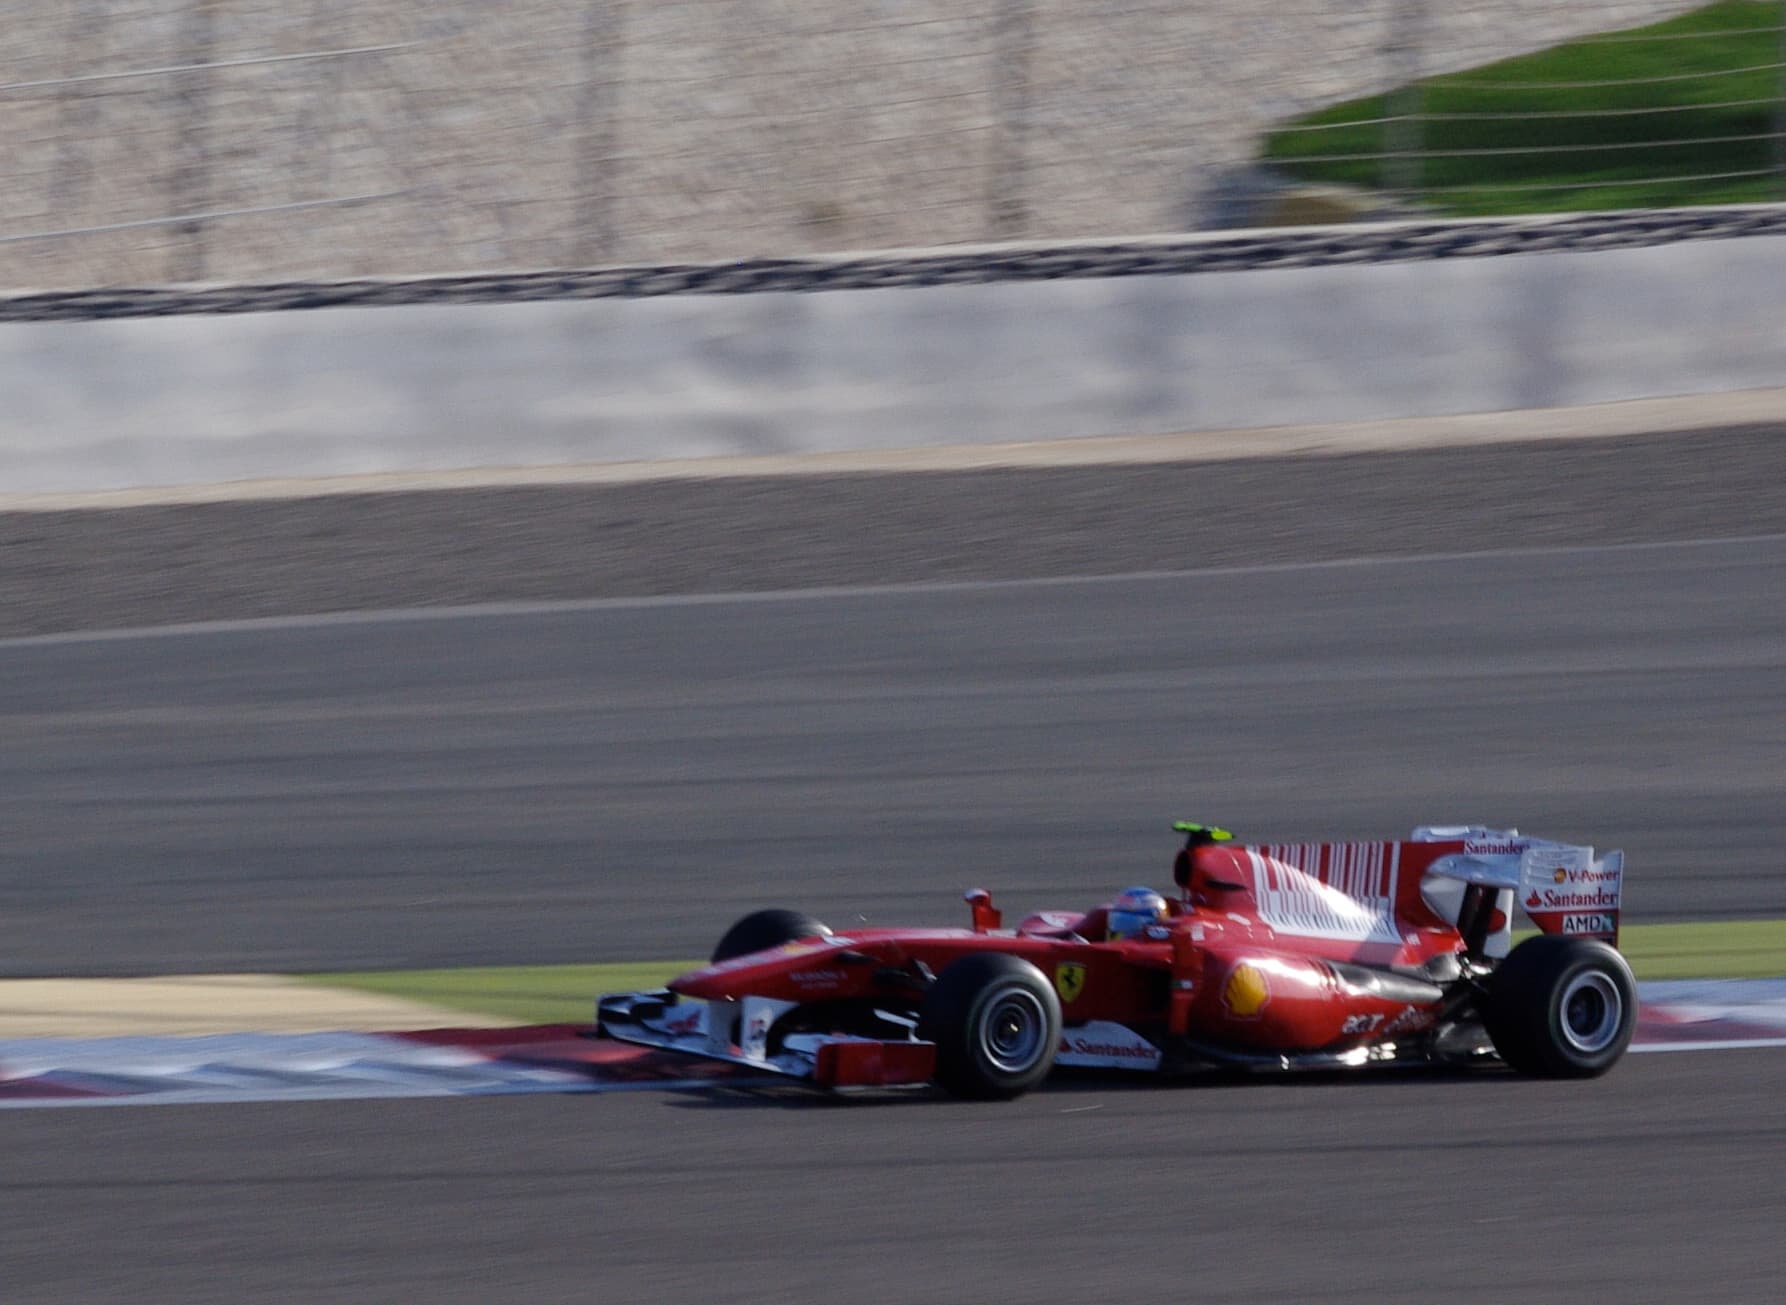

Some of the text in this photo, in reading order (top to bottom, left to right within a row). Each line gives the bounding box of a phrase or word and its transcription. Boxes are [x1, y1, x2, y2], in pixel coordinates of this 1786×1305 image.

[1464, 839, 1529, 855] Santander
[1568, 869, 1618, 882] V-Power
[1544, 887, 1617, 908] Santander
[1565, 915, 1600, 932] AMD
[1074, 1038, 1157, 1059] Santander
